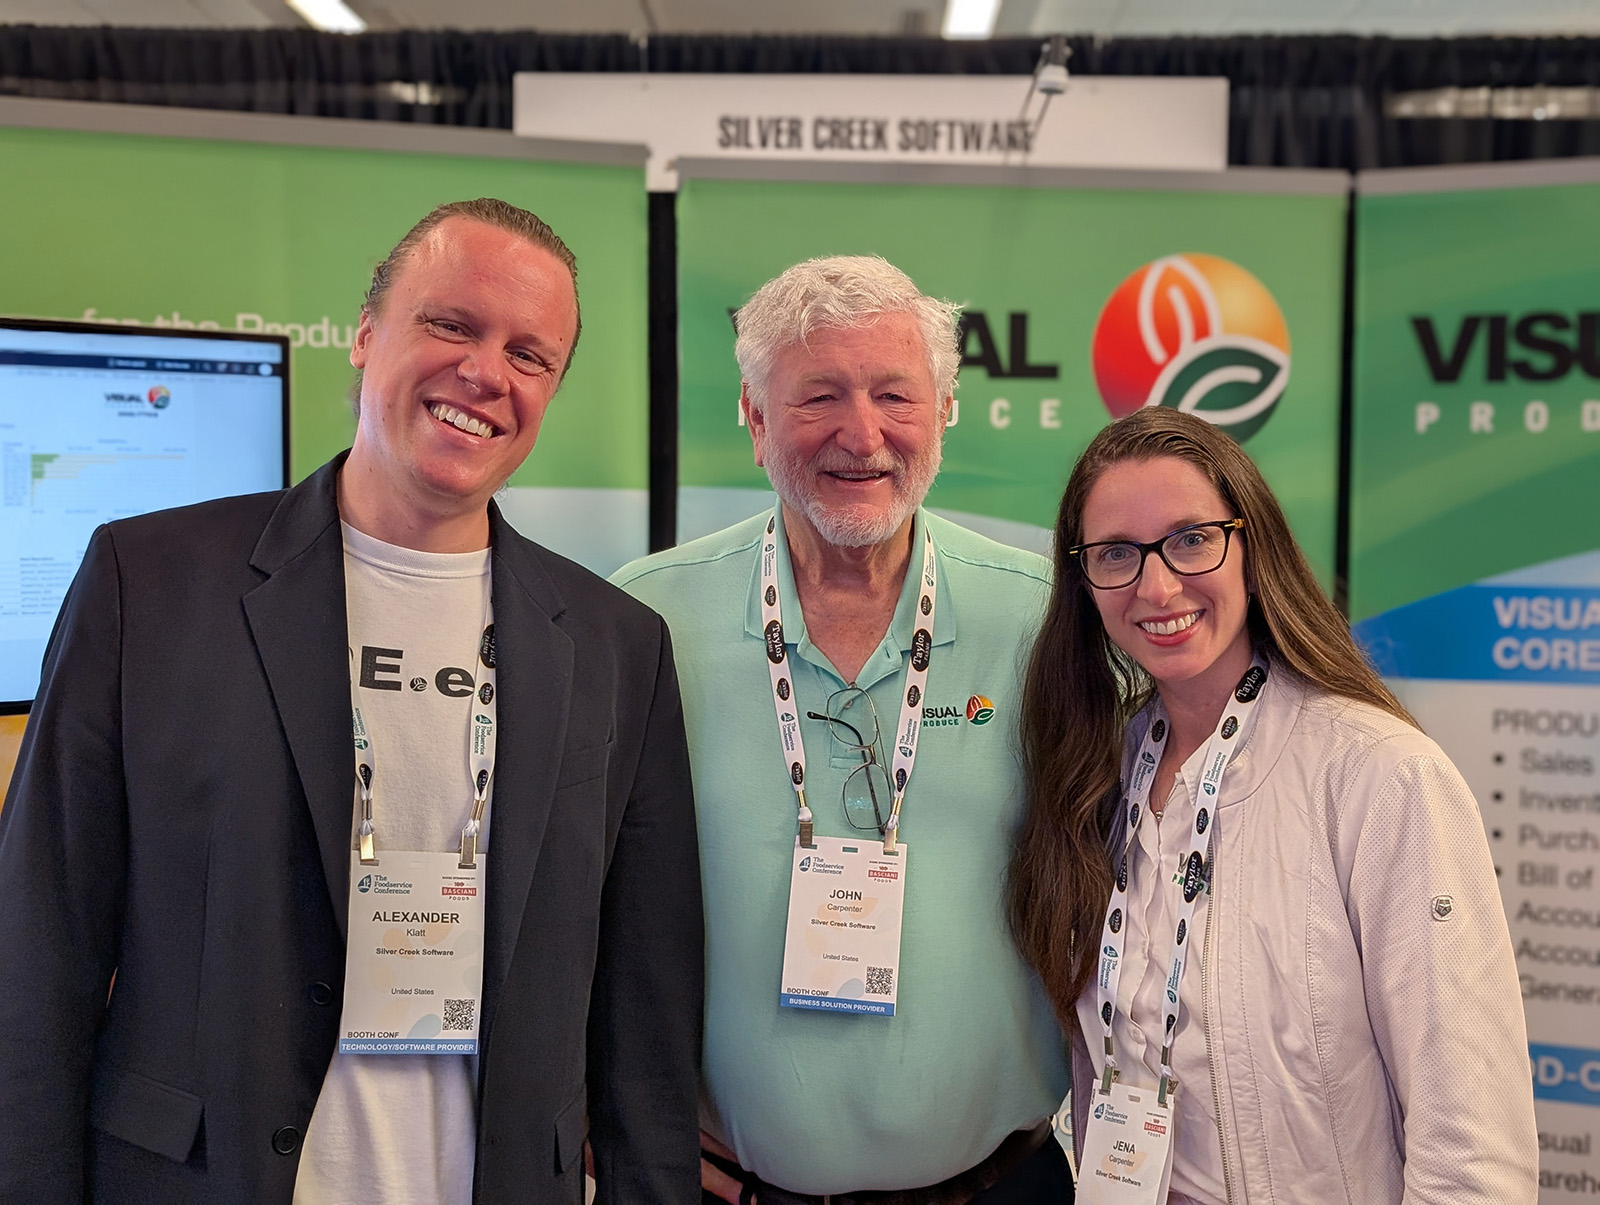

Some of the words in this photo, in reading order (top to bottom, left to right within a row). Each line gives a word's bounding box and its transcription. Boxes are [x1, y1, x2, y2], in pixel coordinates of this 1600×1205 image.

[717, 116, 803, 149] SILVER
[812, 117, 890, 151] CREEK
[897, 118, 1034, 152] SOFTWARE
[771, 624, 783, 658] Taylor
[912, 632, 925, 665] Taylor
[1491, 637, 1600, 671] CORE
[1236, 669, 1261, 699] Taylor
[922, 706, 963, 719] ISUAL
[920, 718, 959, 727] RODUCE
[812, 862, 844, 870] Foodservice
[1184, 856, 1197, 895] Taylor
[1517, 861, 1558, 888] Bill
[1565, 865, 1594, 890] of
[443, 887, 476, 895] BASCIANI
[829, 889, 862, 901] JOHN
[826, 903, 863, 914] Carpenter
[372, 911, 460, 924] ALEXANDER
[811, 918, 829, 926] Silver
[829, 920, 848, 928] Creek
[849, 922, 876, 930] Software
[406, 928, 426, 937] Klatt
[376, 948, 397, 956] Silver
[399, 948, 420, 956] Creek
[422, 948, 454, 956] Software
[822, 953, 841, 961] United
[1103, 958, 1112, 990] Foodservice
[787, 987, 810, 995] BOOTH
[789, 998, 820, 1007] BUSINESS
[821, 1001, 852, 1010] SOLUTION
[853, 1003, 885, 1013] PROVIDER
[341, 1043, 435, 1051] TECHNOLOGY/SOFTWARE
[437, 1043, 474, 1051] PROVIDER
[1112, 1140, 1136, 1155] JENA
[1108, 1154, 1135, 1167] Carpenter
[1095, 1169, 1108, 1178] Silver
[1108, 1172, 1121, 1182] Creek
[1121, 1175, 1142, 1187] Software
